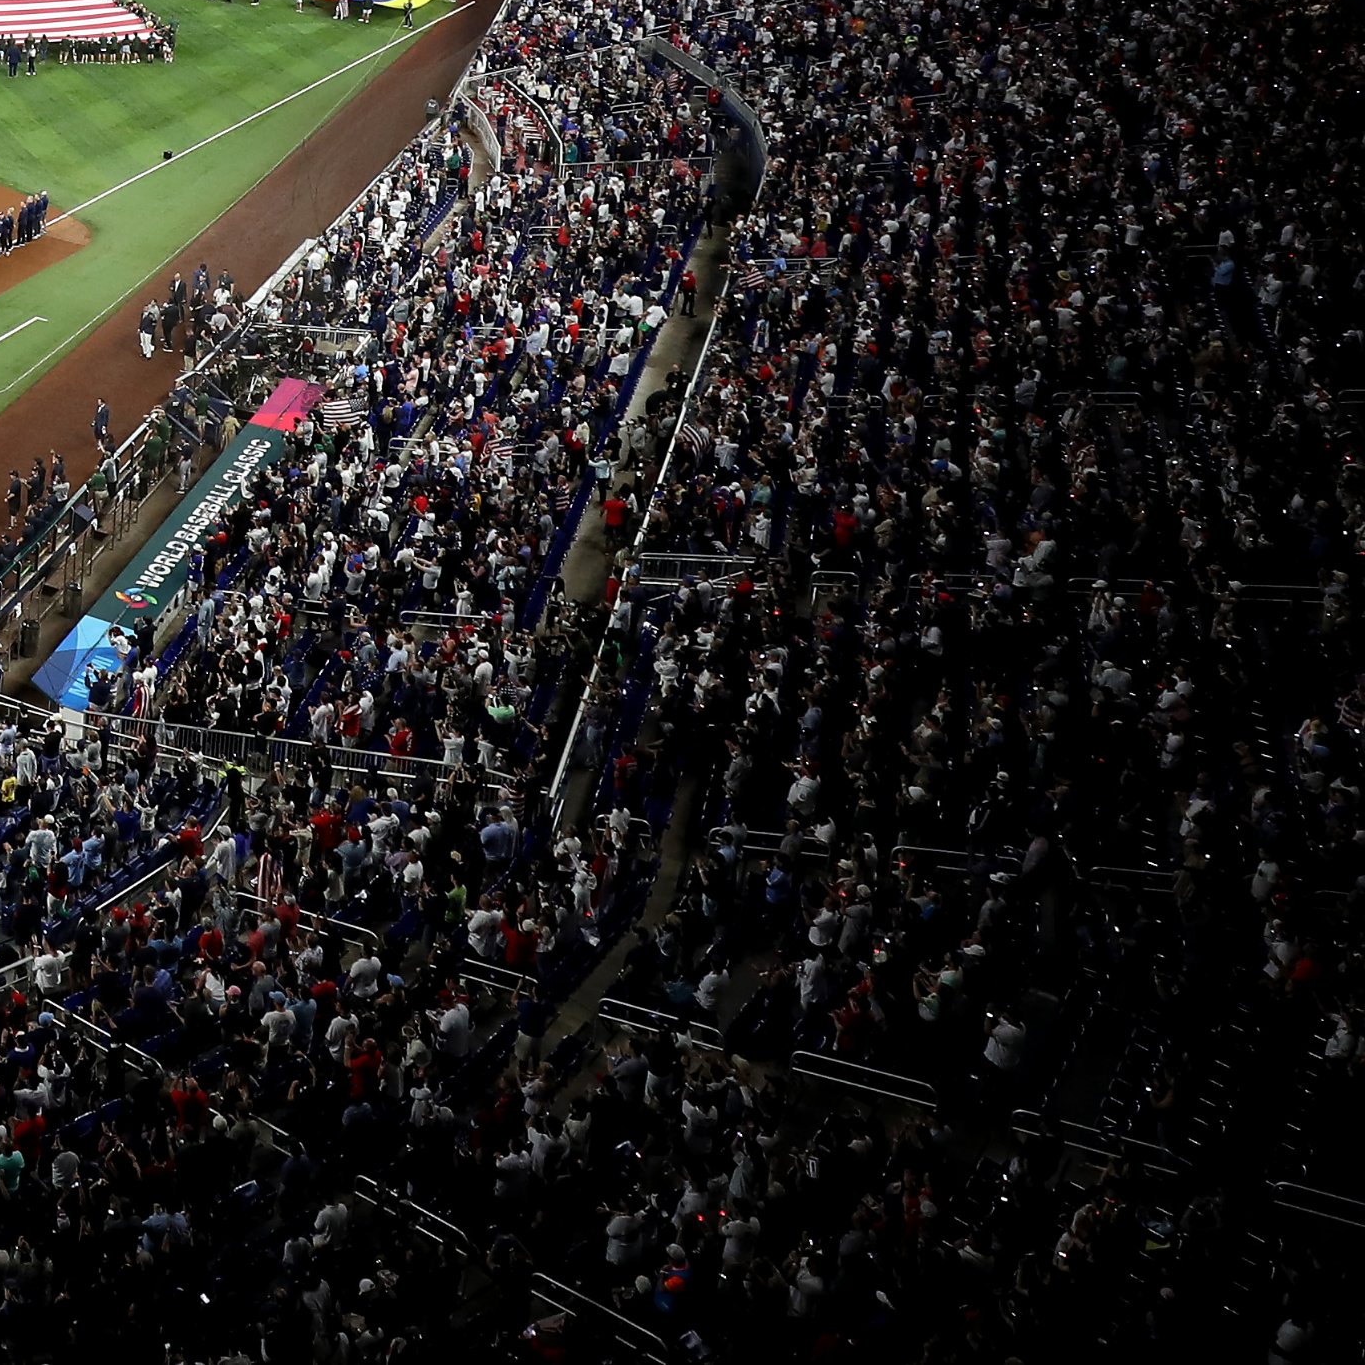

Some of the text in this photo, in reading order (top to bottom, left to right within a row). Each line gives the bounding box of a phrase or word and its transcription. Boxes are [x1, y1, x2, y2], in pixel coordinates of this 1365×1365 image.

[135, 438, 272, 589] WORLD BASEBALL CLASSIC
